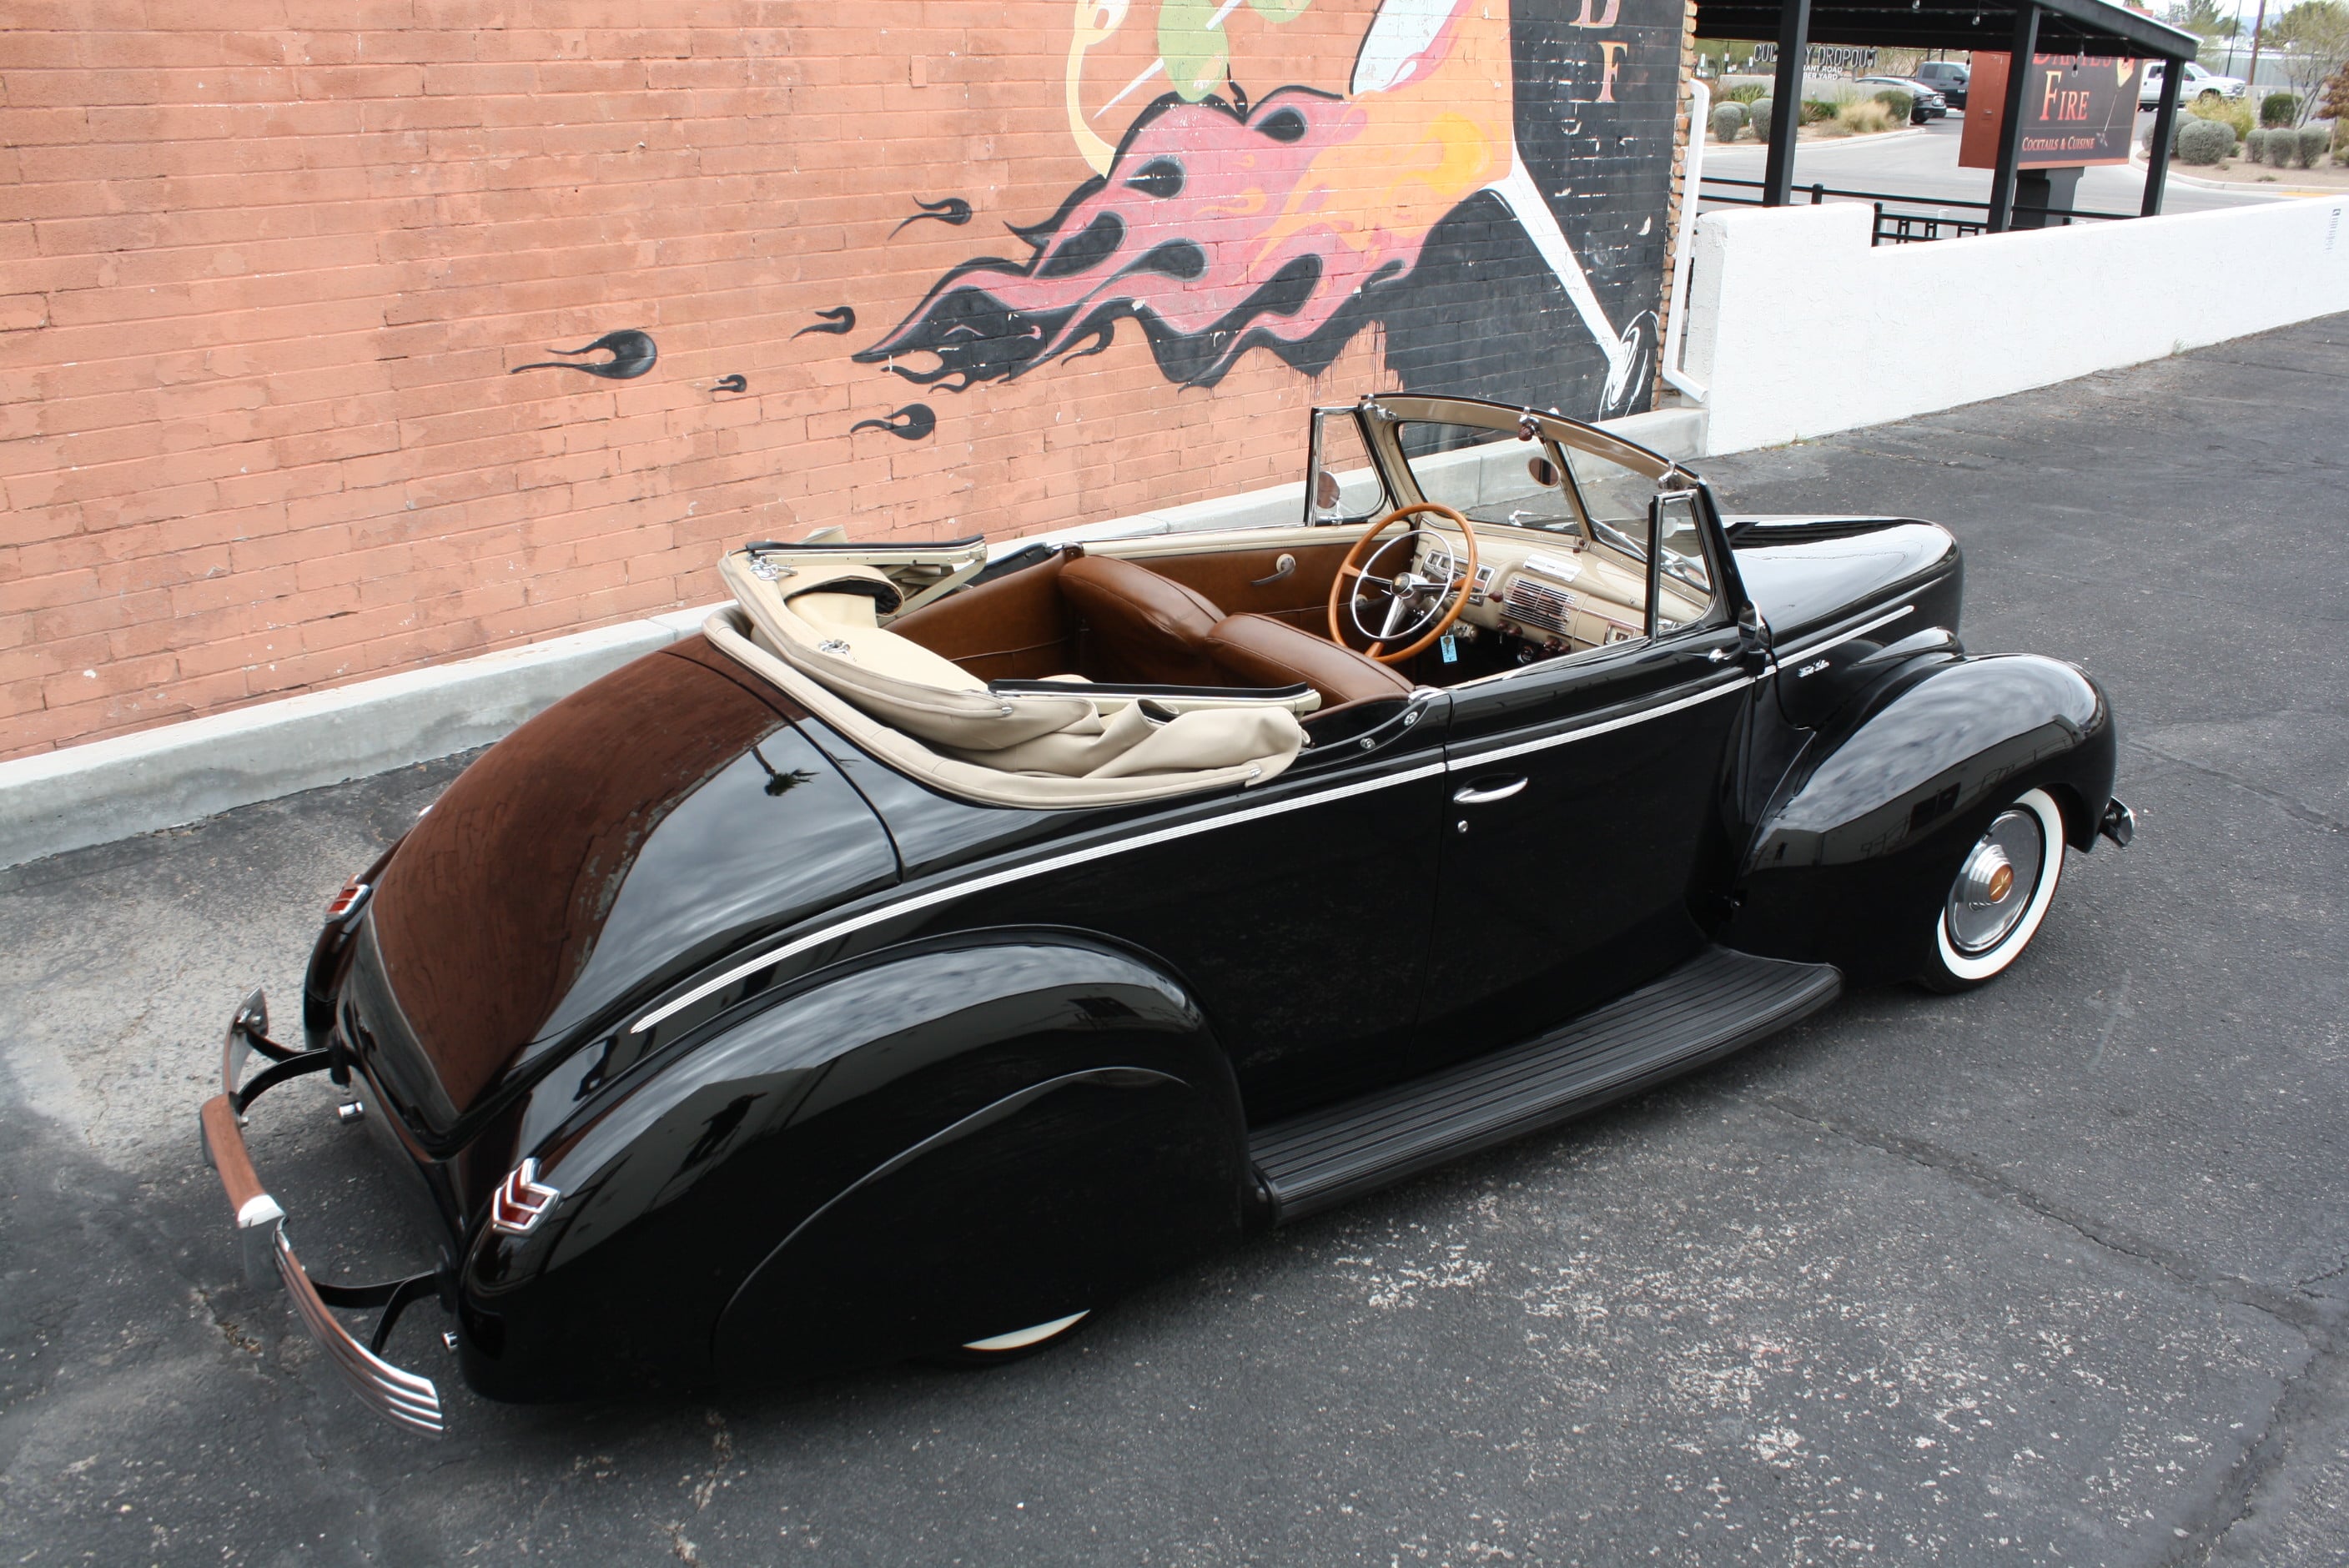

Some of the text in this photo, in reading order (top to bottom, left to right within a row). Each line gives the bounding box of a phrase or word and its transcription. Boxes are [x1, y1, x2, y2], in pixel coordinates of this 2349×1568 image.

[1818, 46, 1876, 68] DROPOUT
[1594, 41, 1628, 103] F
[1818, 73, 1838, 81] YARD
[2039, 70, 2090, 121] FIRE
[2022, 136, 2095, 151] COCKTAILS & CUISINE
